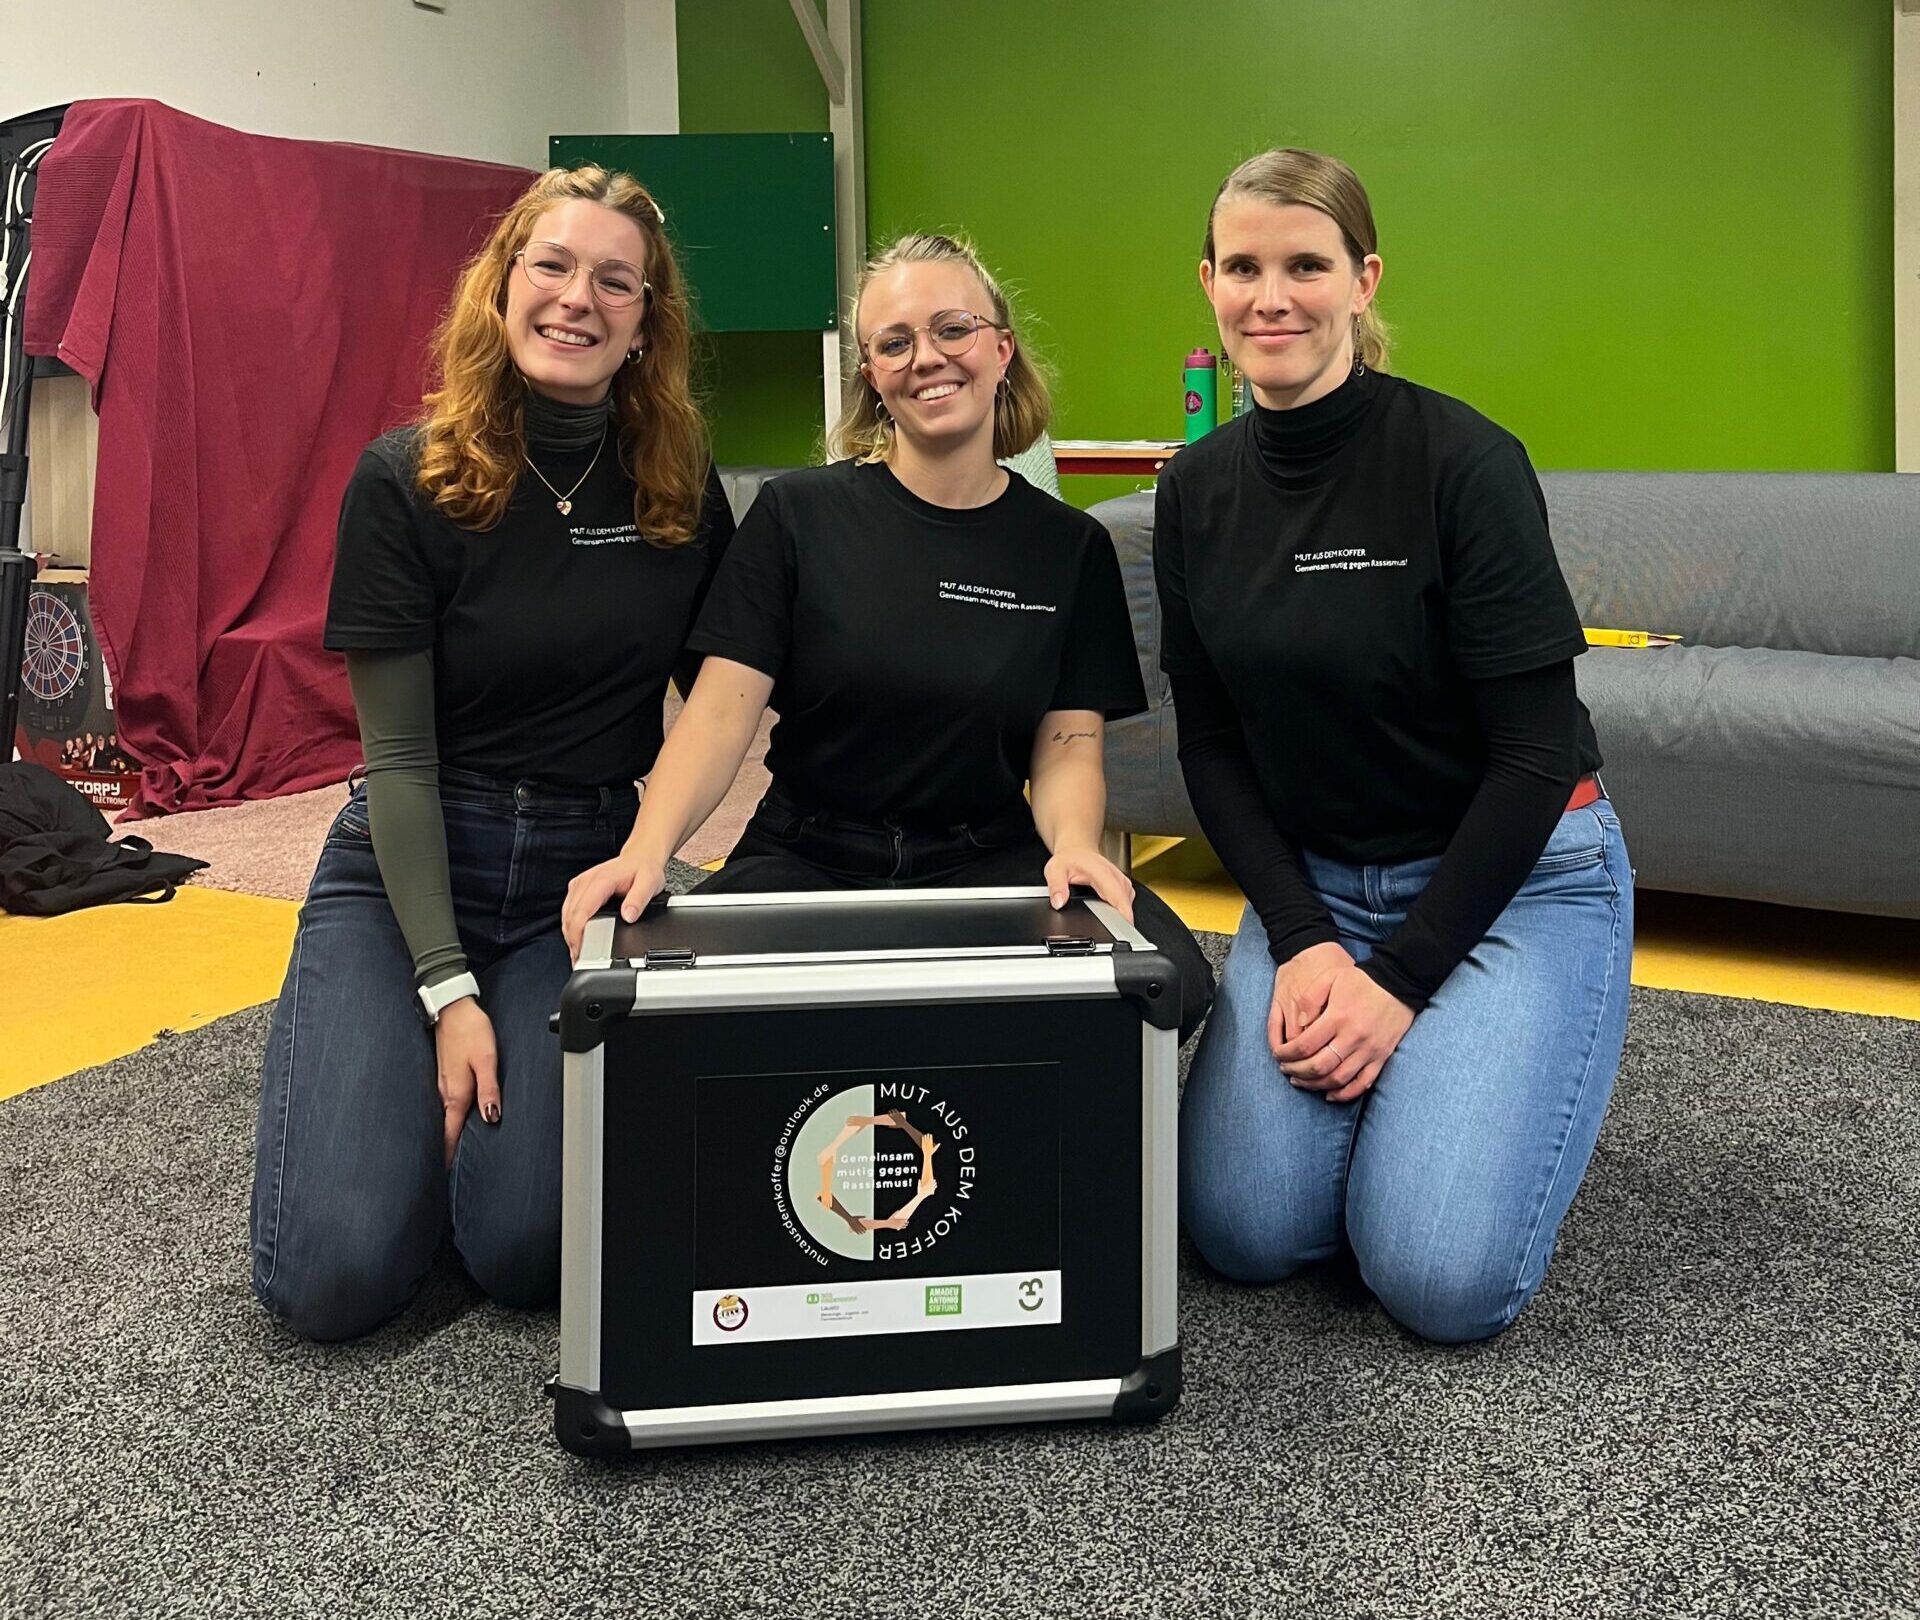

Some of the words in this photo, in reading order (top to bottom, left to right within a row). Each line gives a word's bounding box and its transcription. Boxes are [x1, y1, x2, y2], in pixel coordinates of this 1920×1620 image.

[570, 527, 585, 535] MUT
[597, 526, 611, 535] DEM
[1294, 553, 1311, 562] MUT
[1312, 551, 1324, 560] AUS
[1324, 550, 1338, 559] DEM
[1338, 548, 1366, 558] KOFFER
[1295, 563, 1329, 573] Gemeinsam
[1330, 561, 1348, 570] mutig
[1349, 560, 1370, 570] gegen
[1371, 558, 1408, 568] Rassismus!
[940, 581, 956, 590] MUT
[958, 584, 972, 593] AUS
[973, 586, 989, 595] DEM
[990, 588, 1016, 599] KOFFER
[939, 591, 979, 604] Gemeinsam
[980, 598, 999, 608] mutig
[1000, 600, 1020, 610] gegen
[1020, 603, 1056, 612] Rassismus!
[66, 780, 120, 796] CORPY
[92, 795, 128, 806] ELECTRONIC
[880, 1082, 930, 1104] MUT
[930, 1100, 968, 1140] AUS
[840, 1152, 914, 1164] Gemeinsam
[771, 1083, 829, 1267] mutausdemkoffer@outlook.de
[836, 1167, 874, 1178] mutig
[879, 1166, 918, 1177] gegen
[956, 1147, 975, 1200] DEM
[842, 1178, 912, 1191] Rassismus!
[879, 1206, 962, 1260] KOFFER
[930, 1286, 959, 1296] AMADEU
[929, 1295, 959, 1305] ANTONIO
[929, 1304, 958, 1313] STIFTUNG
